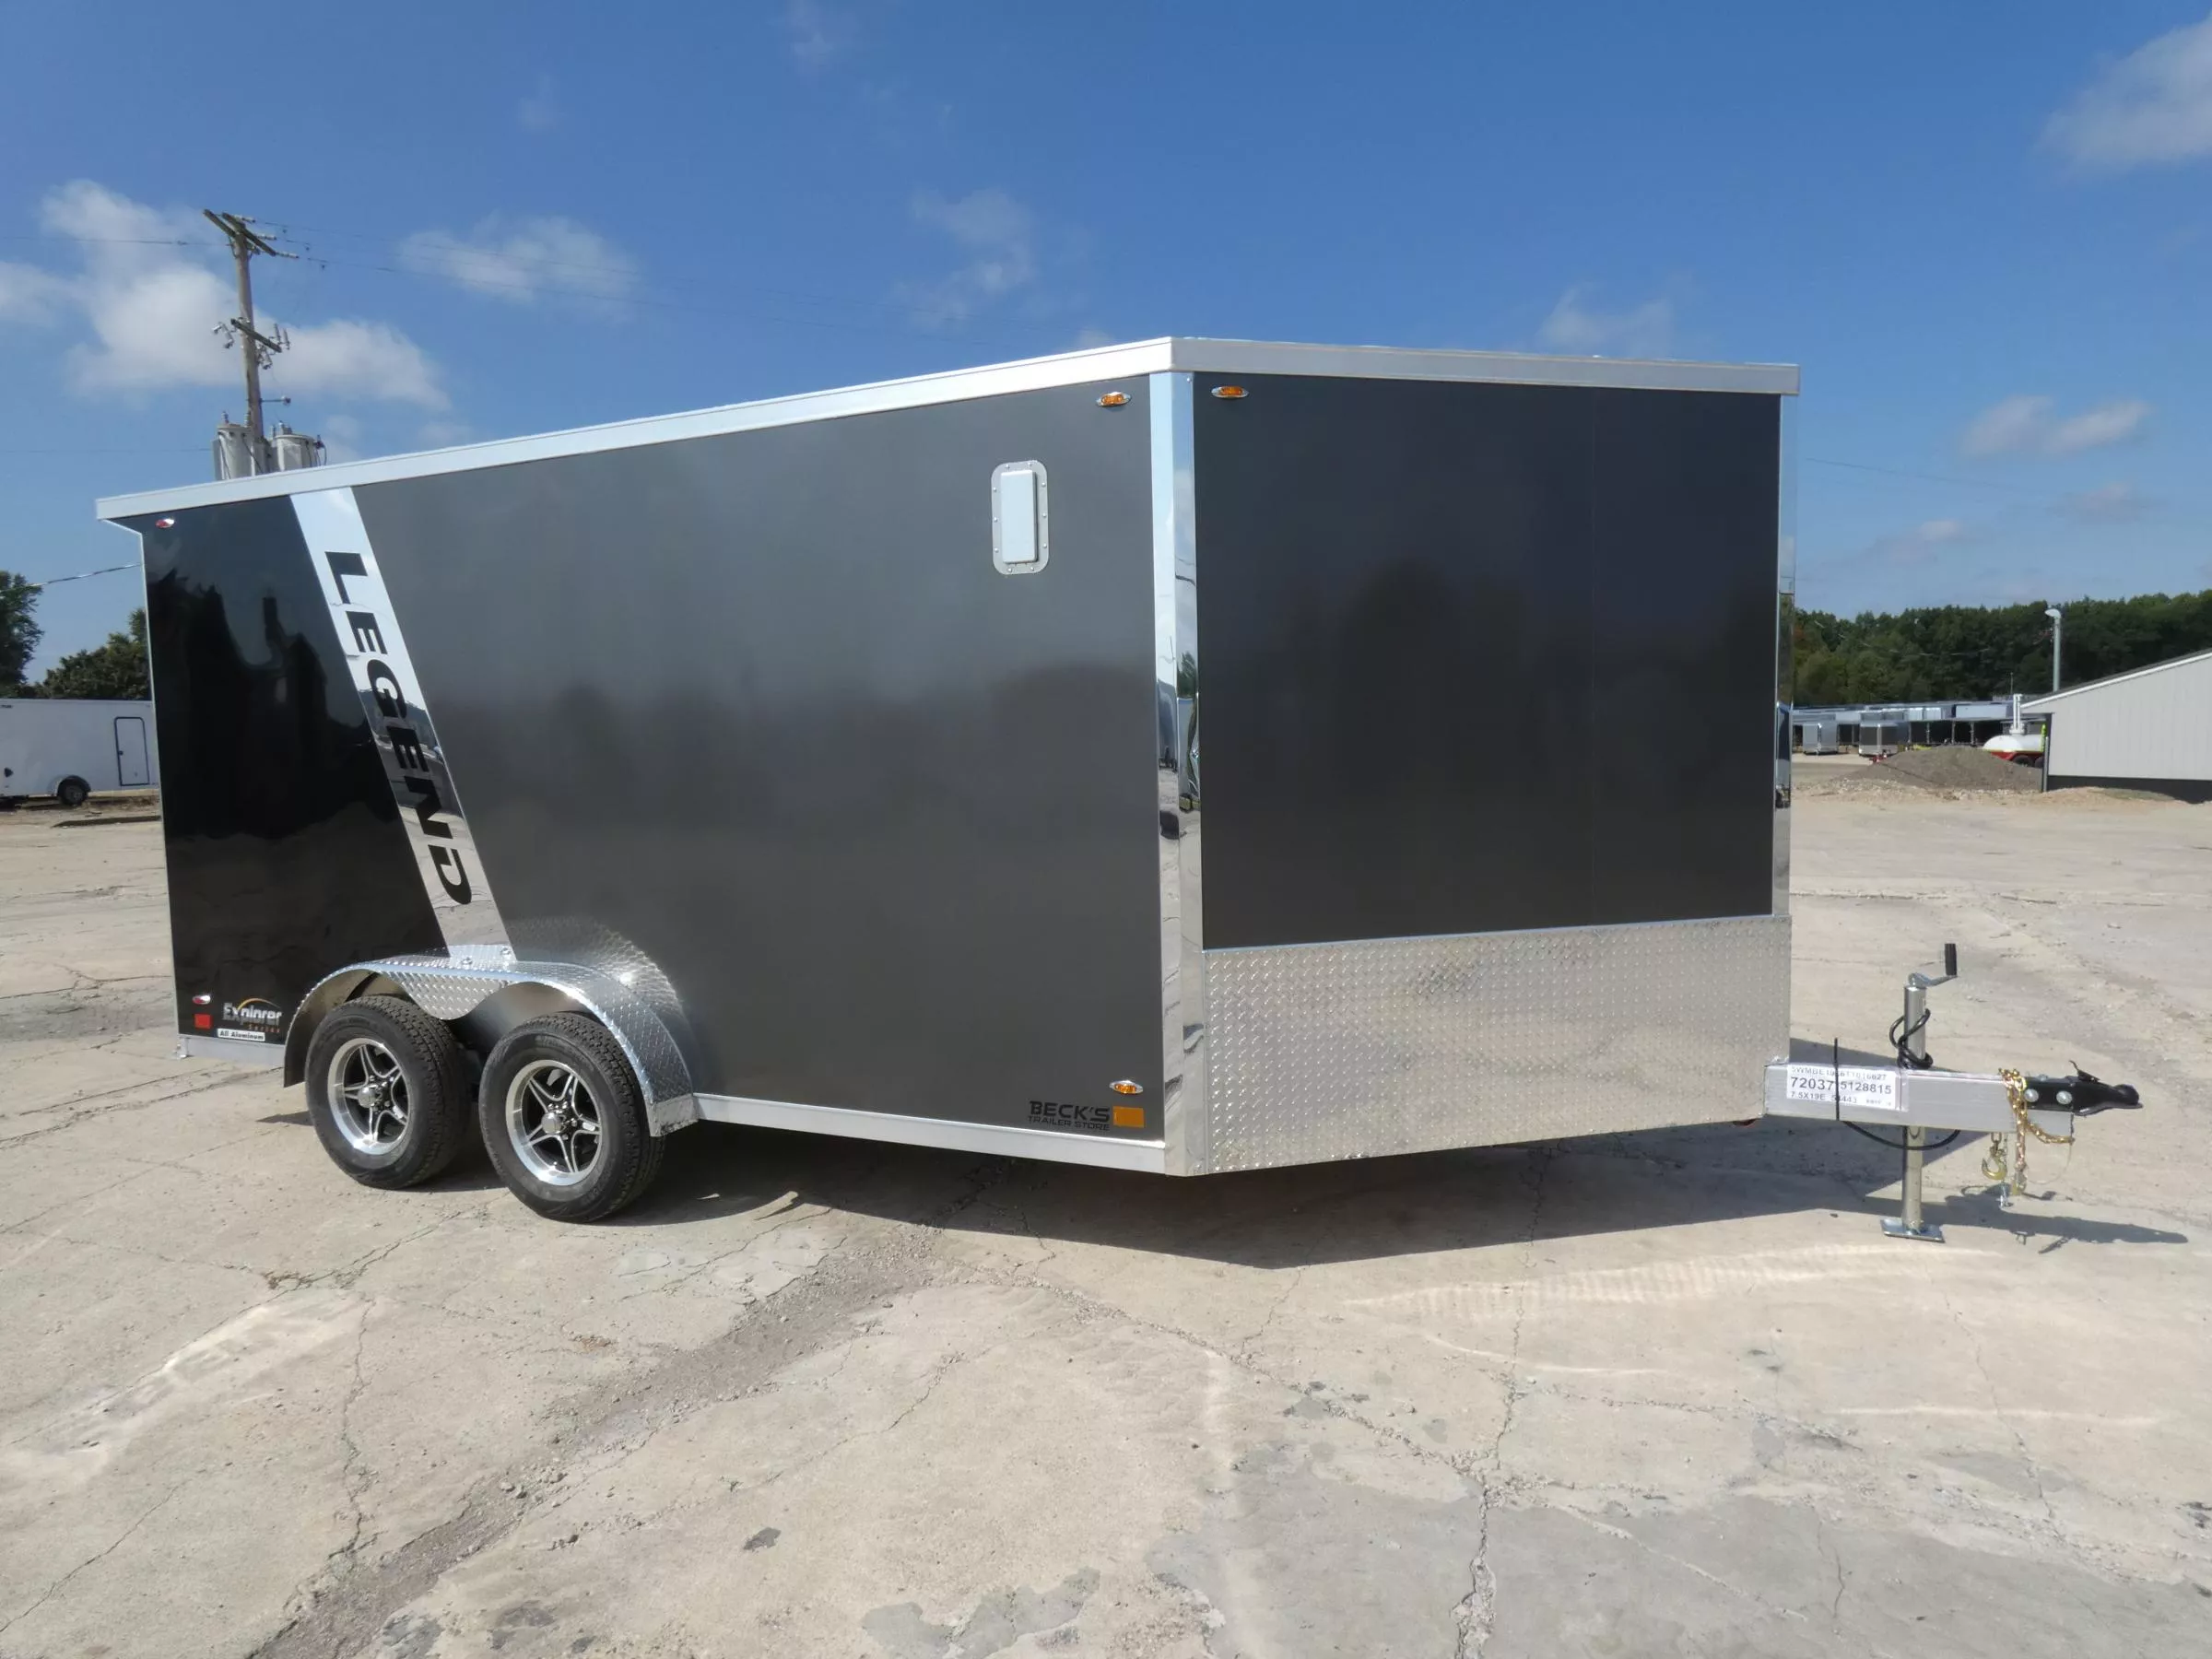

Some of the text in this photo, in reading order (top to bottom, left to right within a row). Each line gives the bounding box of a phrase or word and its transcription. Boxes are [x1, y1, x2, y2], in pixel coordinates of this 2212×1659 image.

[324, 551, 472, 905] LEGEND
[230, 1030, 264, 1041] Aluminum
[1029, 1100, 1110, 1123] BECK'S
[1028, 1115, 1110, 1131] TRAILER STORE
